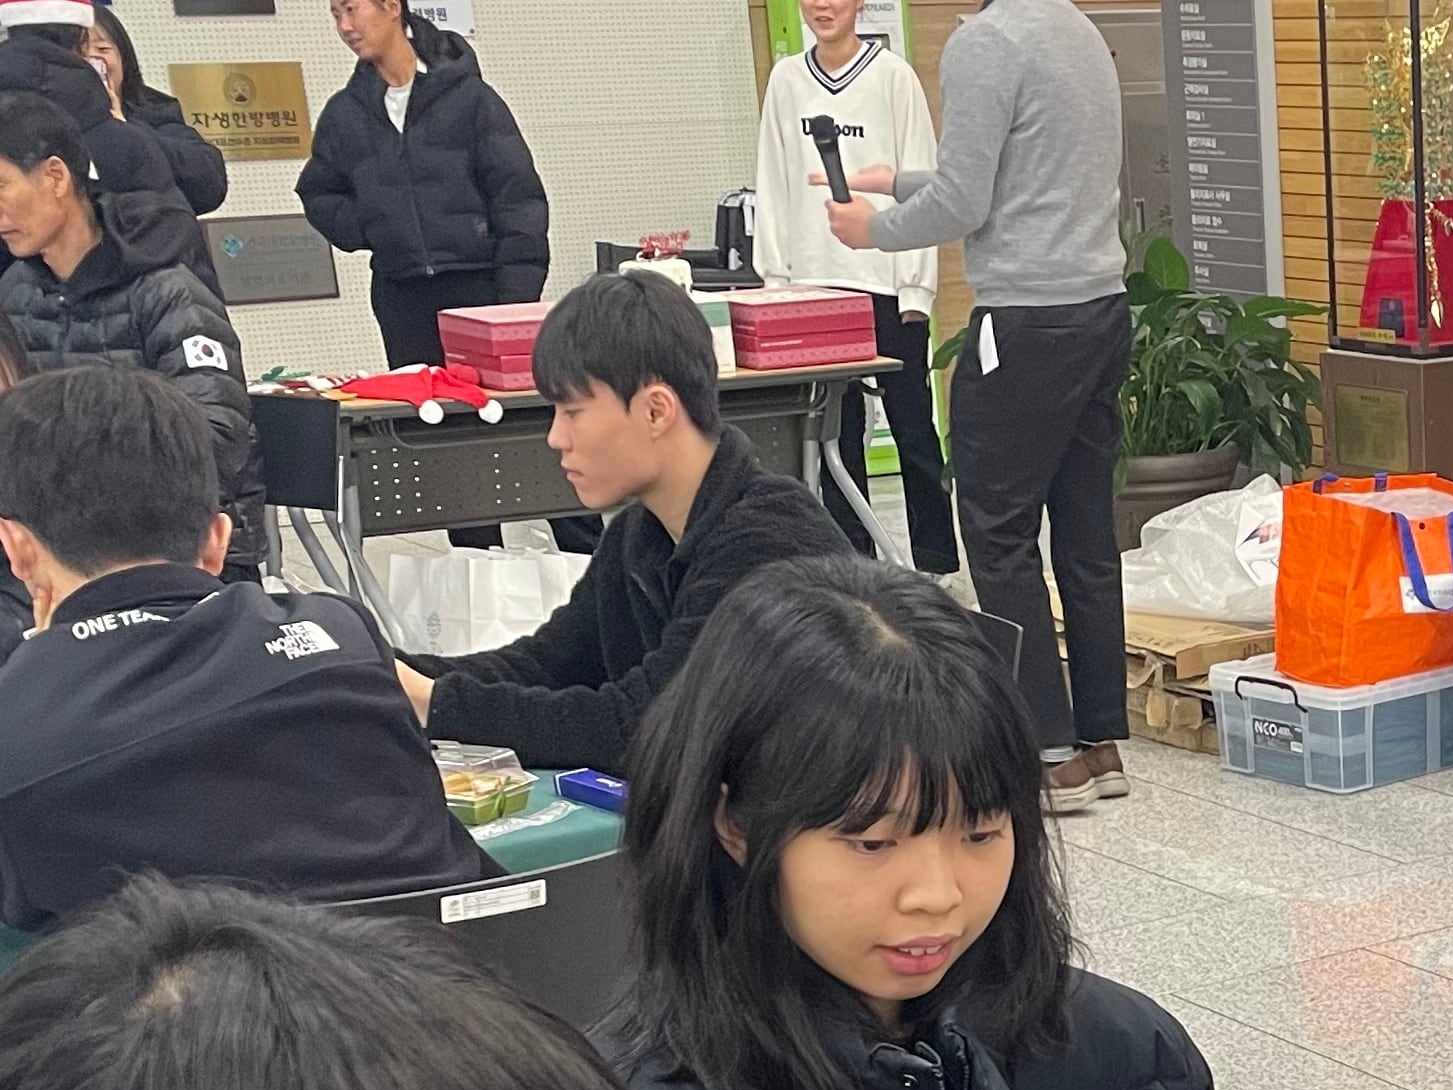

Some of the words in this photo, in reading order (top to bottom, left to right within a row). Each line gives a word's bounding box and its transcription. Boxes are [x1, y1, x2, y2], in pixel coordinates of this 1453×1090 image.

[190, 110, 298, 128] 자생한방병원
[72, 614, 118, 640] ONE
[1254, 720, 1278, 736] NCO
